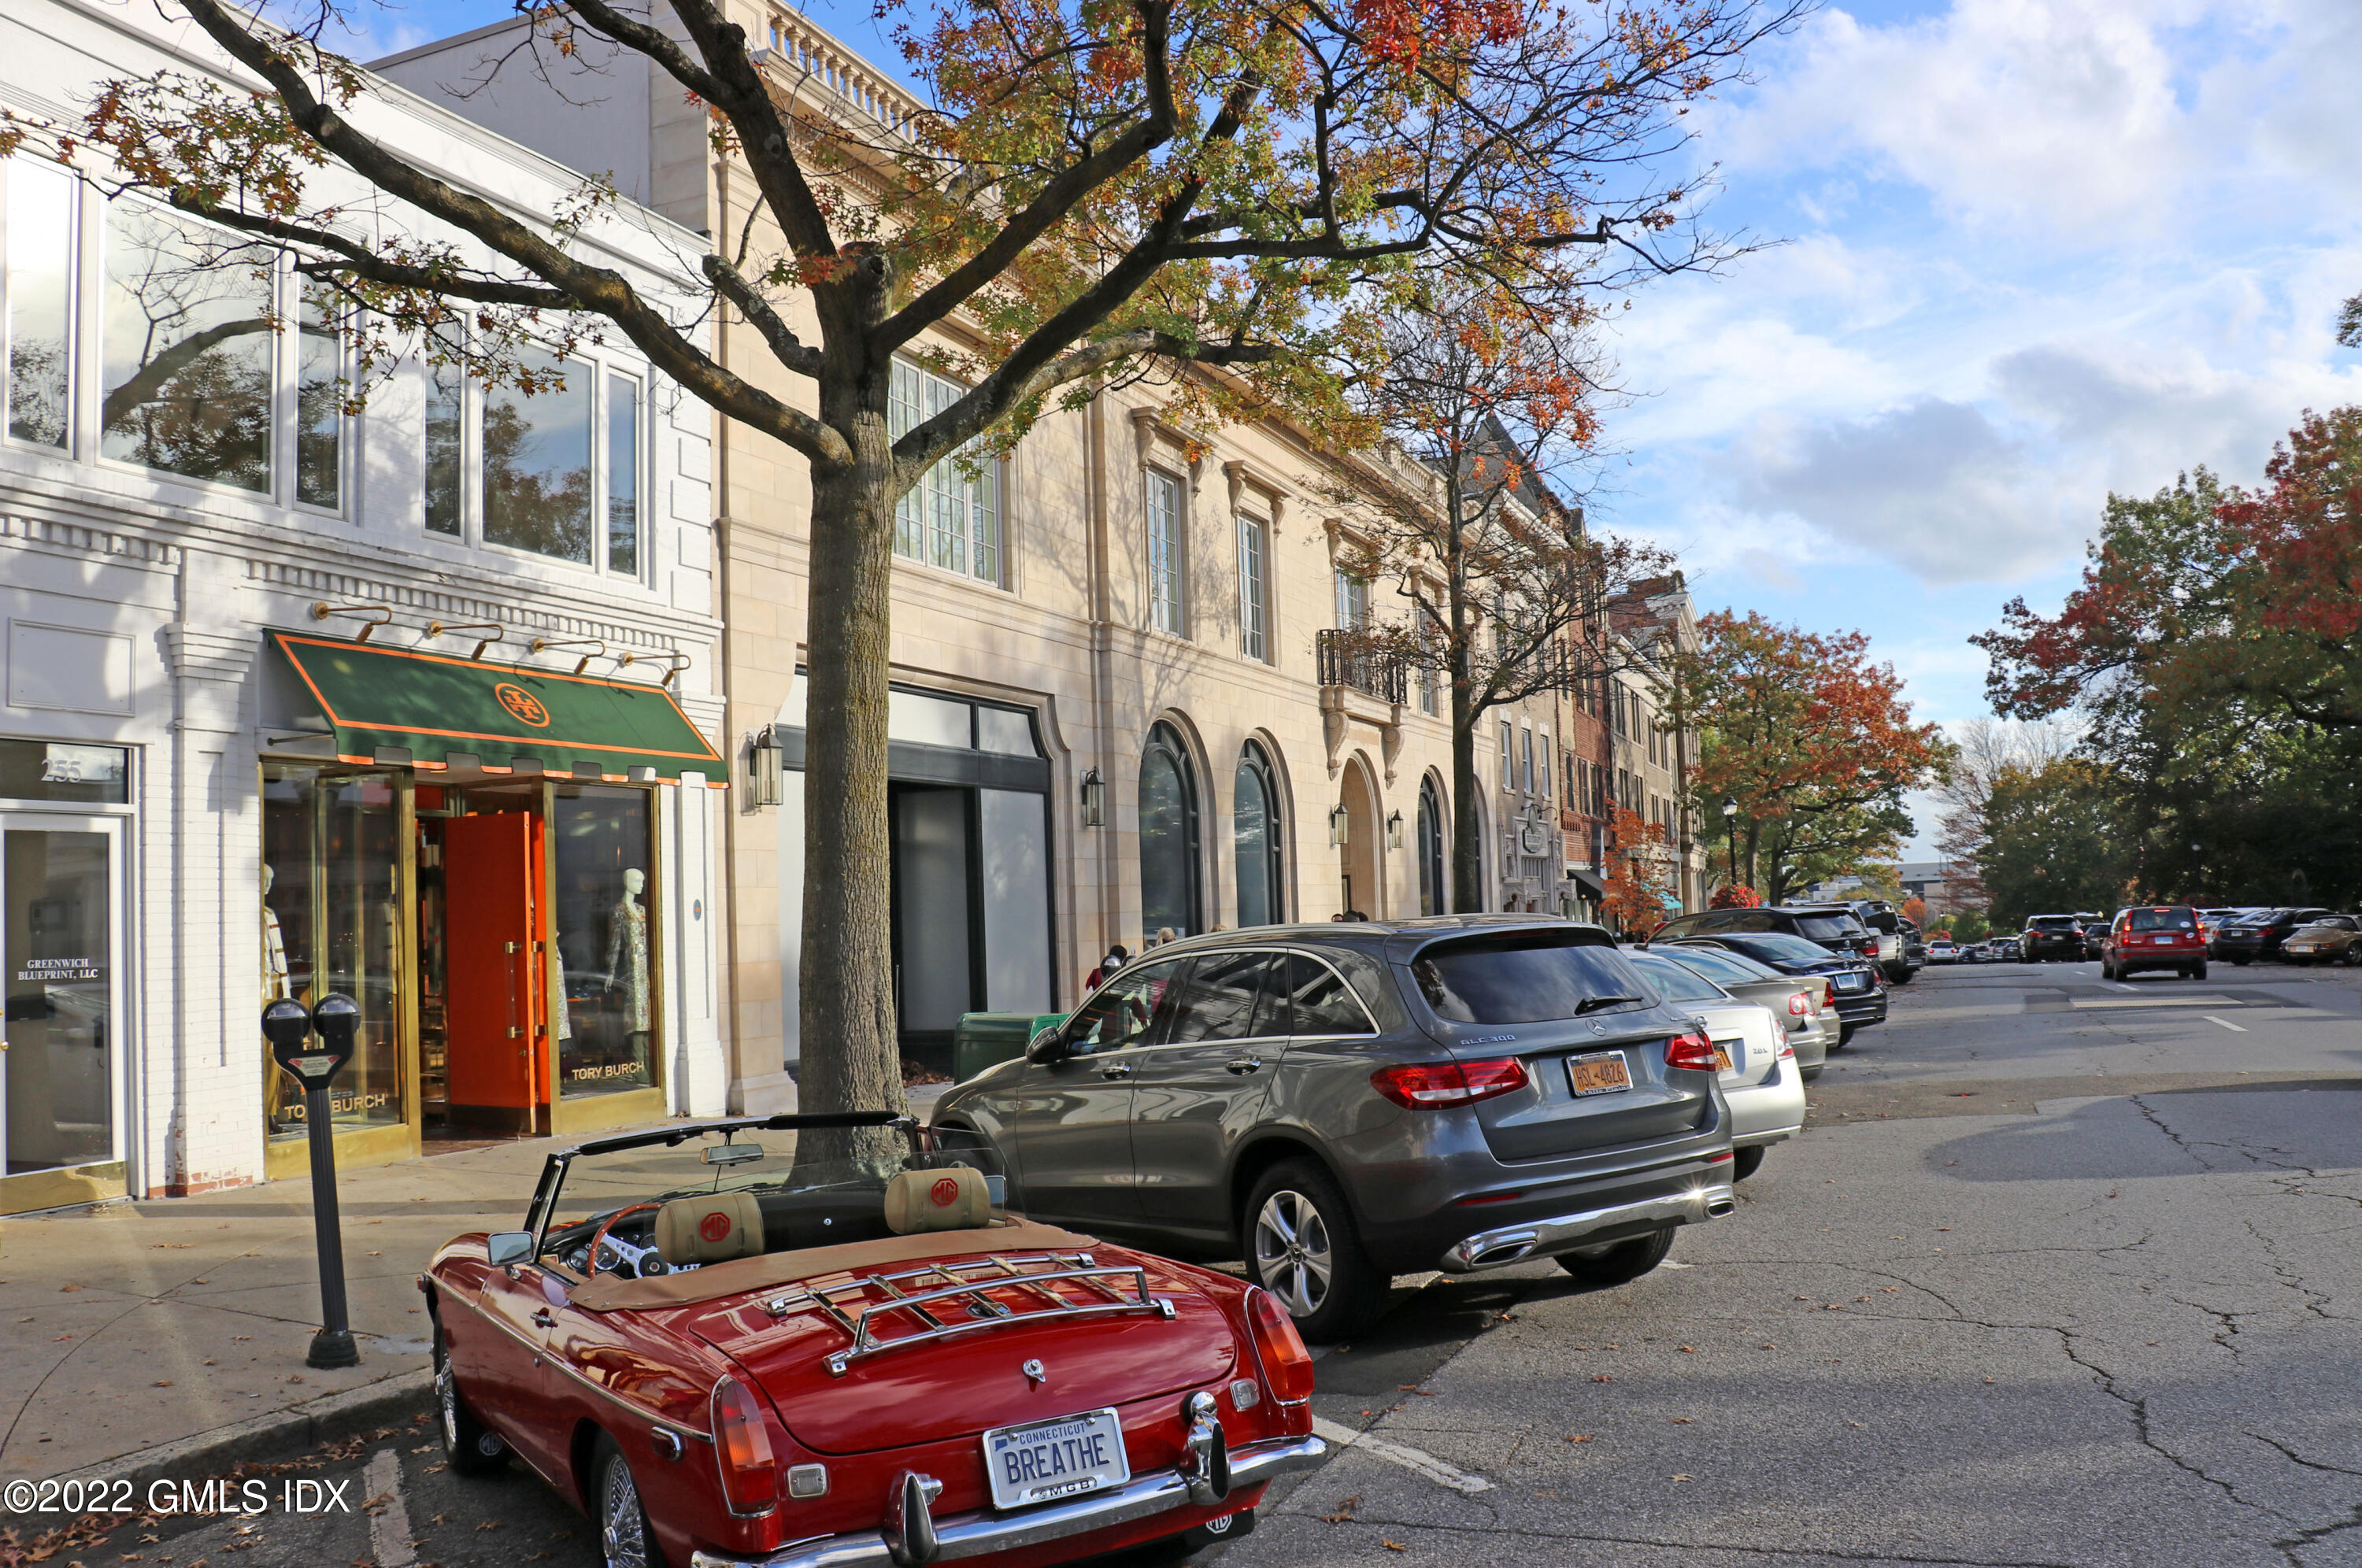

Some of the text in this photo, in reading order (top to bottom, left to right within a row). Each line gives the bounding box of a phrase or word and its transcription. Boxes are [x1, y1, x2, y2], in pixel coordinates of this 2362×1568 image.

[41, 758, 82, 782] 255
[27, 958, 89, 969] GREENWICH
[18, 968, 98, 981] BLUEPRINT, LLC
[572, 1060, 645, 1081] TORY BURCH
[331, 1093, 385, 1114] BURCH
[1020, 1423, 1085, 1444] CONNECTICUT
[1004, 1433, 1110, 1484] BREATHE
